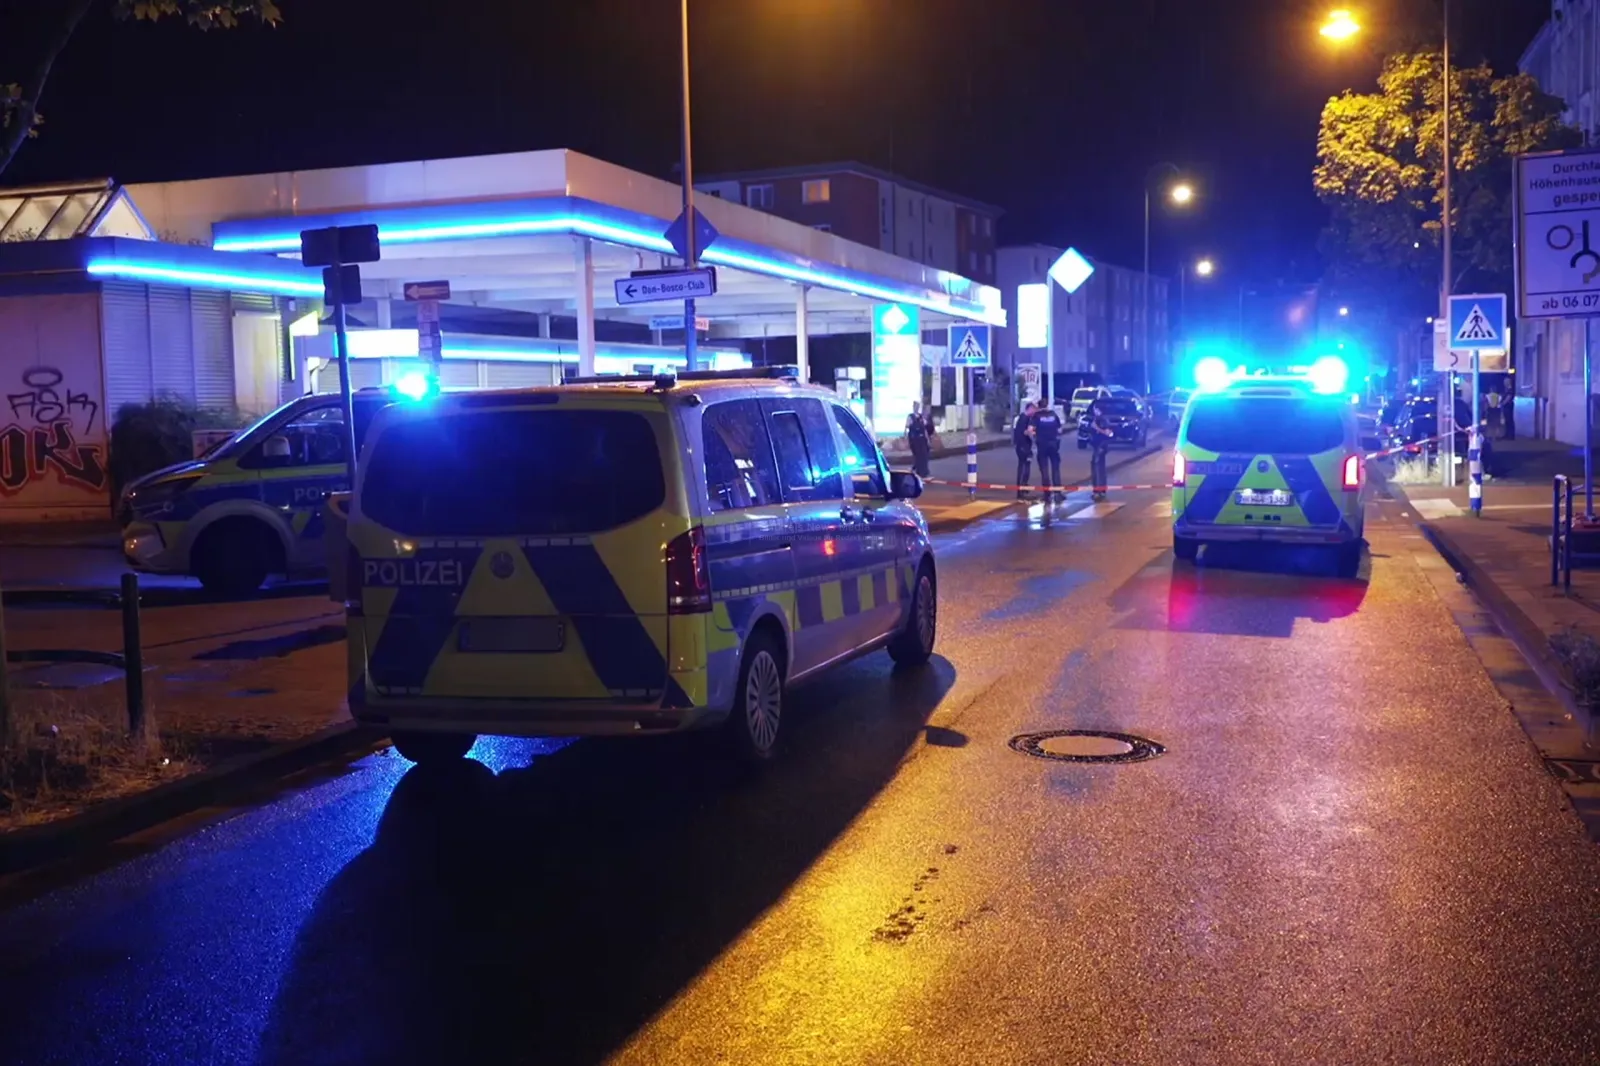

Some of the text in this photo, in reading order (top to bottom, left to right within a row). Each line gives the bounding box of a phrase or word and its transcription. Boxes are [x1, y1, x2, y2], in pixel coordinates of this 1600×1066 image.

[1530, 176, 1600, 190] Höhenhaus
[1553, 191, 1600, 208] gespe
[641, 279, 705, 295] Don-Bosco-Club
[1541, 296, 1559, 309] ab
[364, 559, 463, 585] POLIZEI
